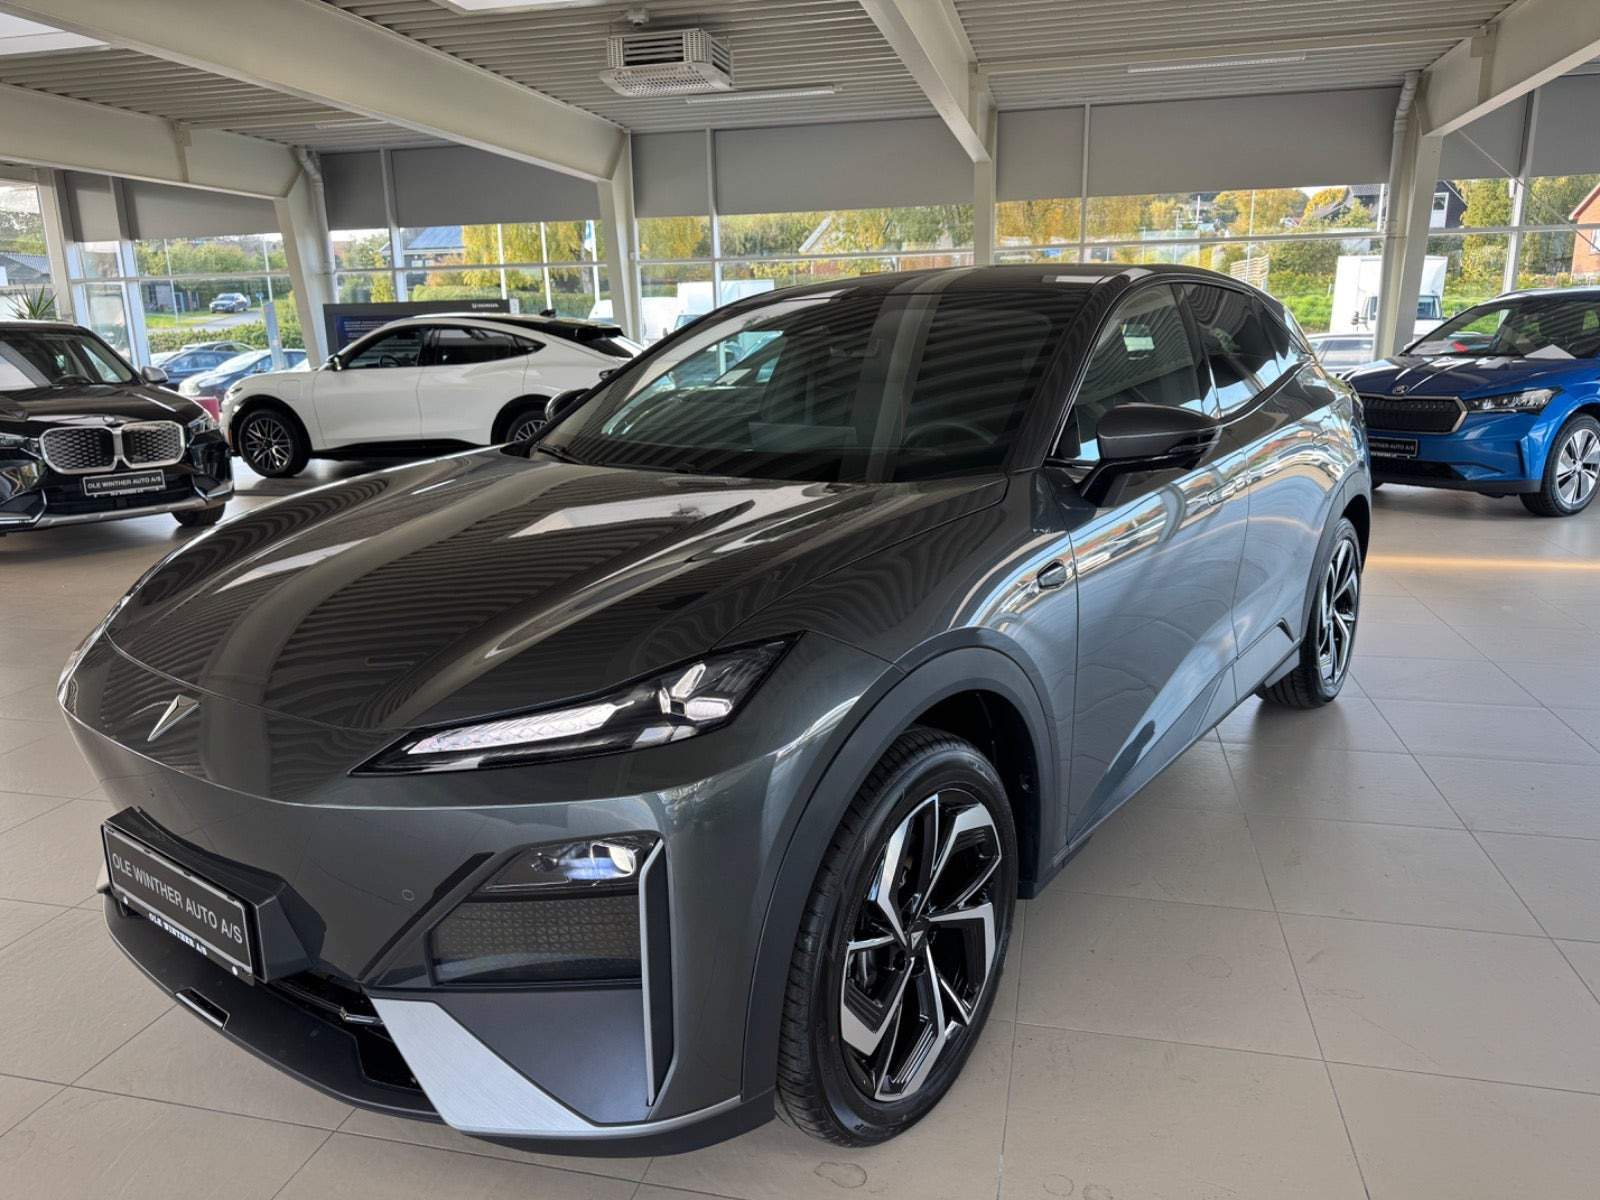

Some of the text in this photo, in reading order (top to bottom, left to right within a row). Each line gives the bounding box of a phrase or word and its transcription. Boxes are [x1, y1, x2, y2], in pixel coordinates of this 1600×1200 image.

[102, 479, 131, 488] WINTHER
[111, 853, 243, 944] OLE WINTHER AUTO A/S
[148, 912, 207, 956] OLE WINTHER A/S
